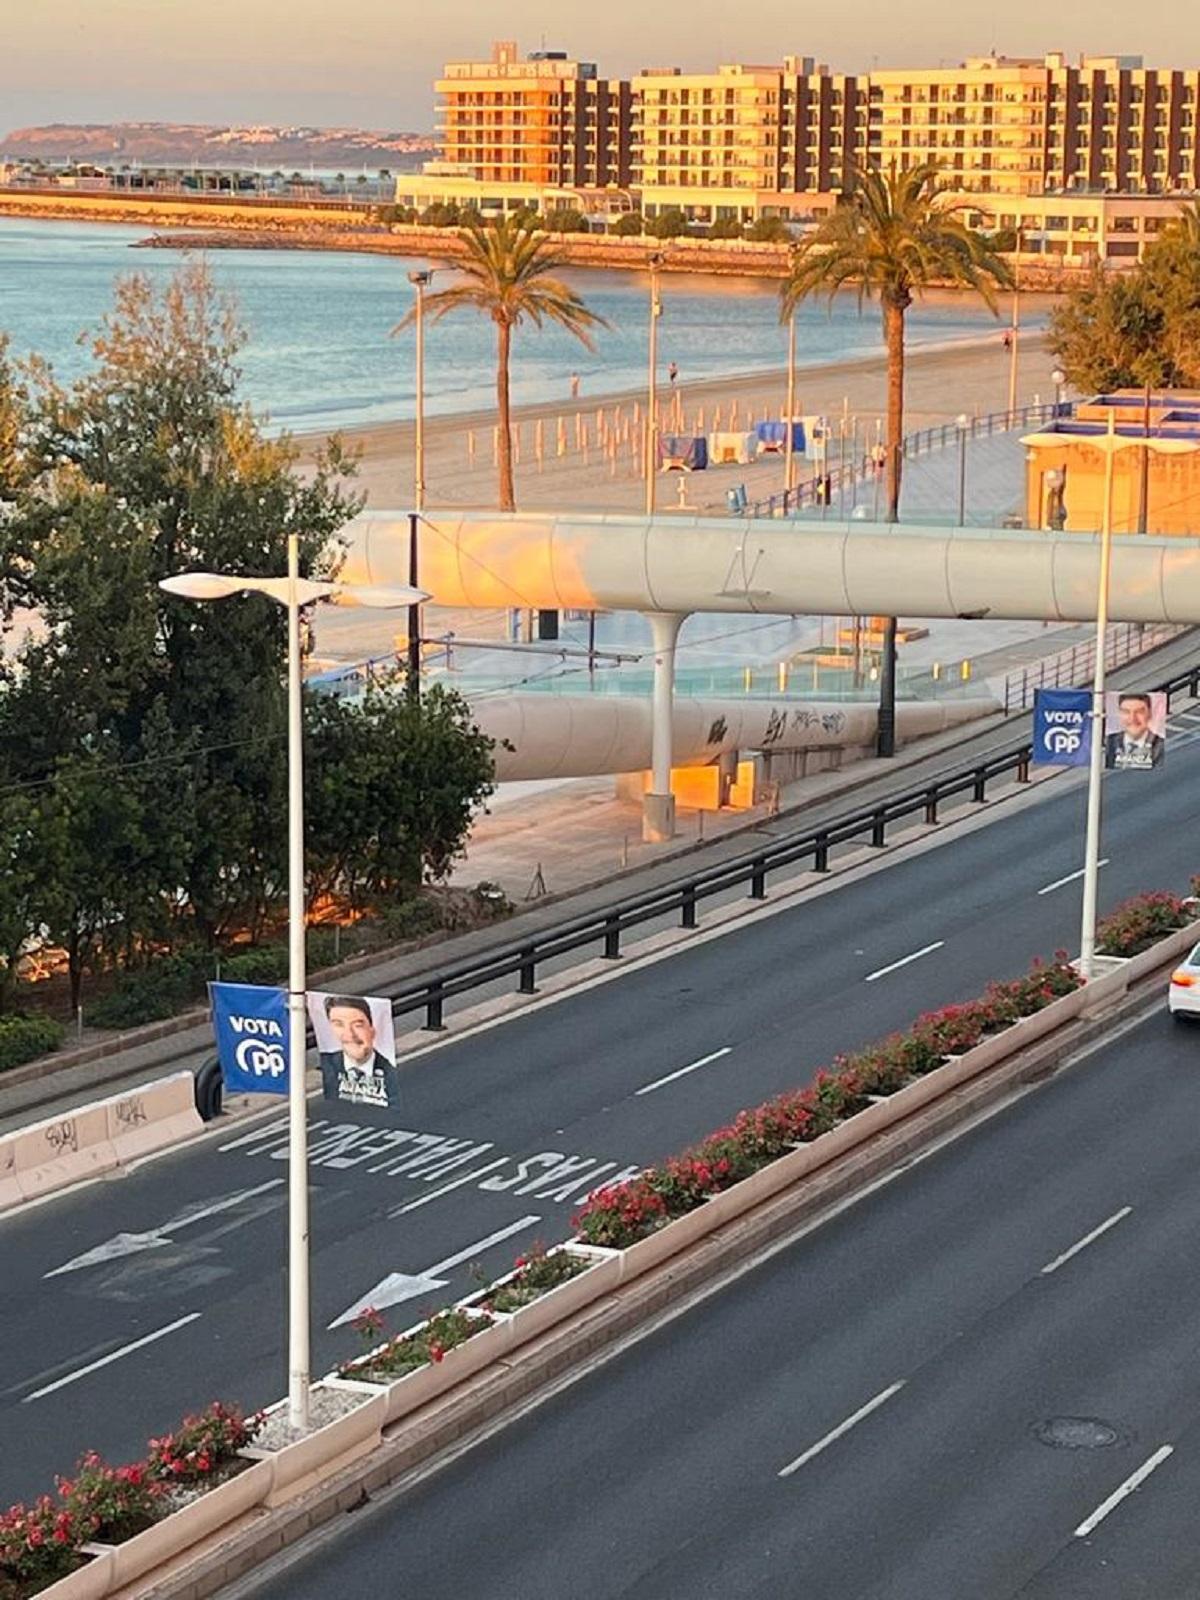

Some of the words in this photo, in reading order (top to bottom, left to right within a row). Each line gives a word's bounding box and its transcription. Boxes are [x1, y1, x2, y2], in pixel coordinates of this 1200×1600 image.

[1044, 711, 1083, 723] VOTA
[229, 1016, 283, 1037] VOTA
[217, 1117, 494, 1181] VALENCIA
